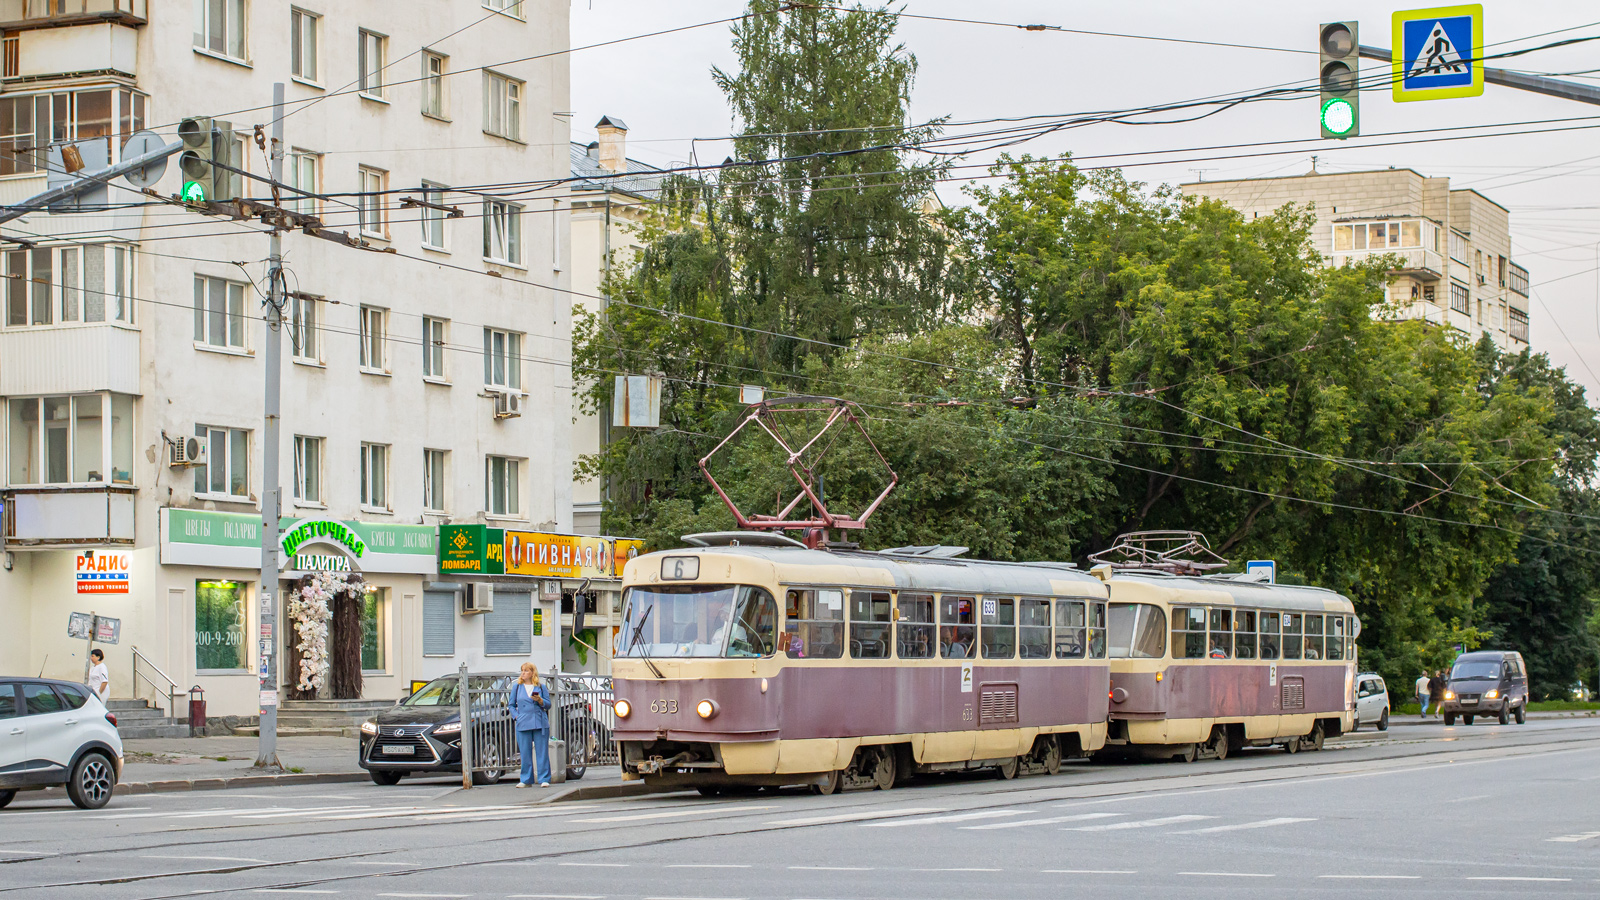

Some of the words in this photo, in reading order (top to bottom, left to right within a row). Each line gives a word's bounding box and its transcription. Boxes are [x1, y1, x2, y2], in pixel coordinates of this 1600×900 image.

[185, 519, 211, 537] ЦВЕТЫ
[224, 521, 257, 540] ПОДАРКИ
[281, 521, 366, 558] ЦВЕТОЧНАЯ
[371, 530, 396, 547] БУКЕТЫ
[402, 531, 432, 548] ДОСТАВКА
[77, 555, 128, 571] РАДИО
[295, 554, 351, 571] ПАЛИТРА
[526, 542, 592, 568] ПИВНАЯ
[442, 560, 481, 570] ЛОМБАРД
[674, 560, 684, 580] 6
[984, 601, 995, 614] 633
[963, 667, 971, 681] 2
[1271, 666, 1276, 678] 2
[650, 699, 679, 714] 633
